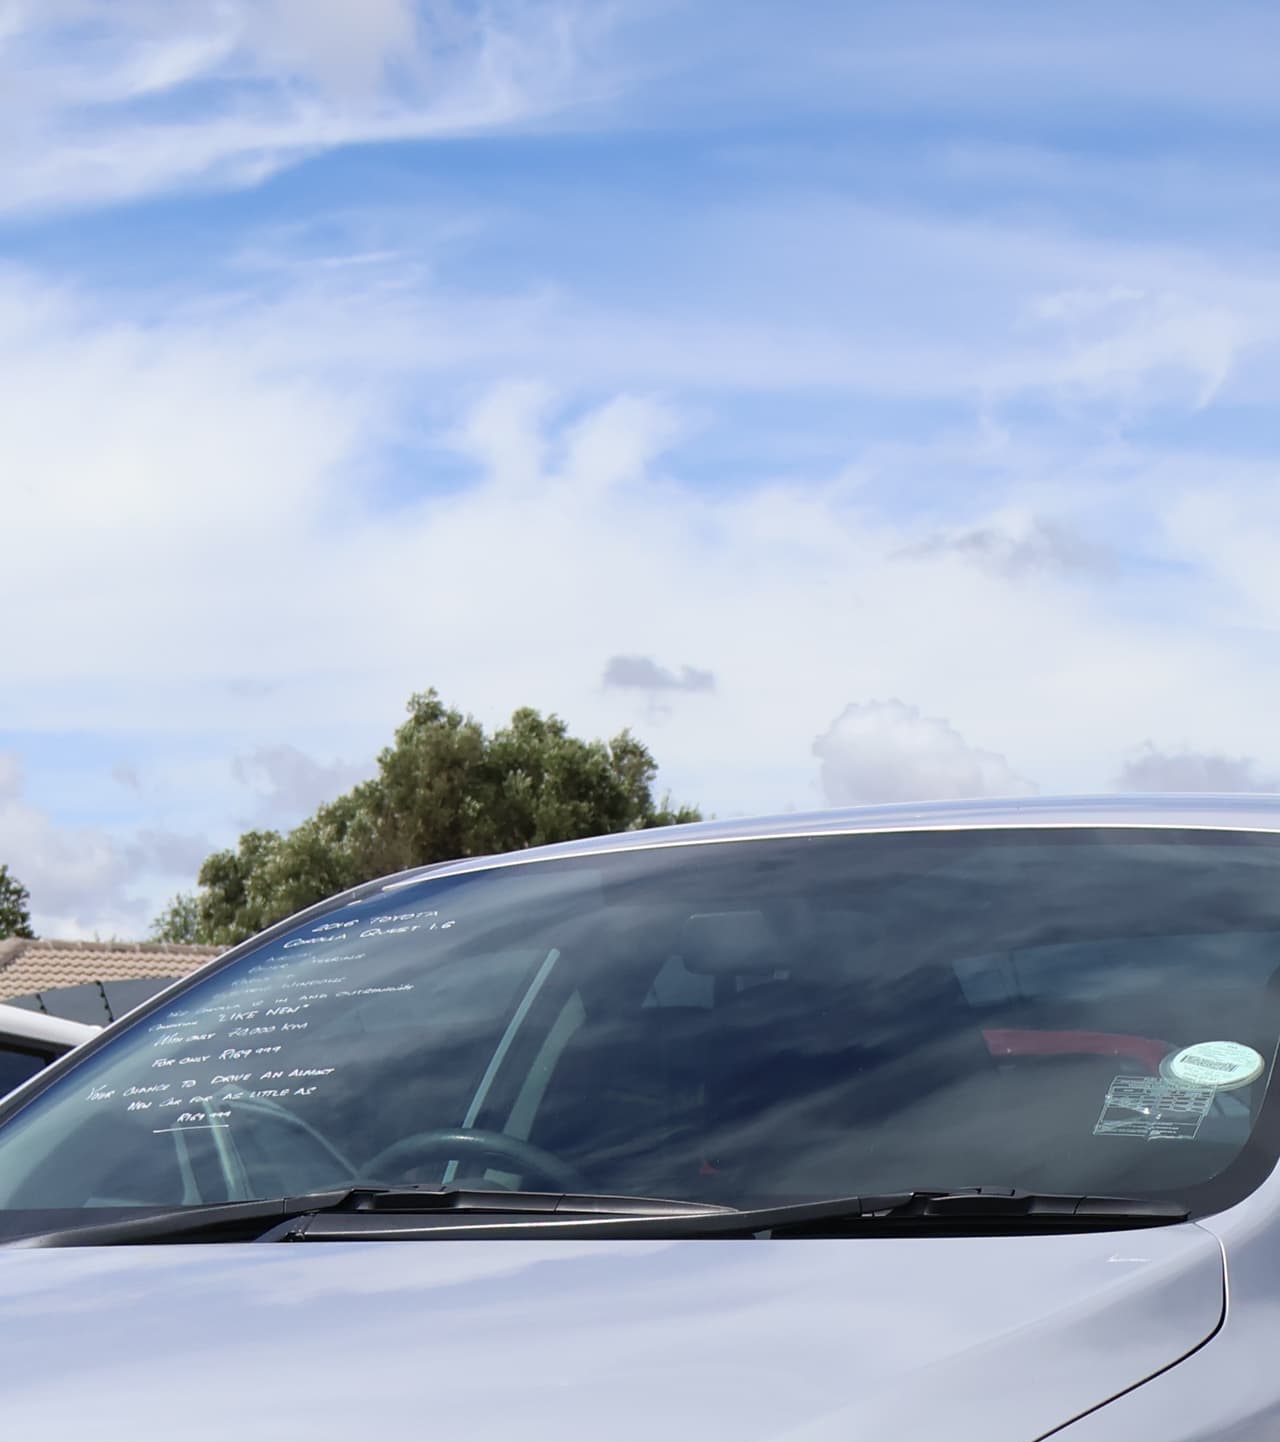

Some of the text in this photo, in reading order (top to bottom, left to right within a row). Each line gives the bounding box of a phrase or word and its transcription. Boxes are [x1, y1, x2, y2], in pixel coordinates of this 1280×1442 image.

[360, 925, 420, 938] QUEST
[152, 1057, 176, 1068] FOR
[181, 1079, 197, 1089] TO
[210, 1072, 252, 1084] DRIVE
[259, 1070, 284, 1080] AN
[222, 1092, 245, 1101] AS
[249, 1087, 290, 1098] LITTLE
[294, 1085, 318, 1096] AS
